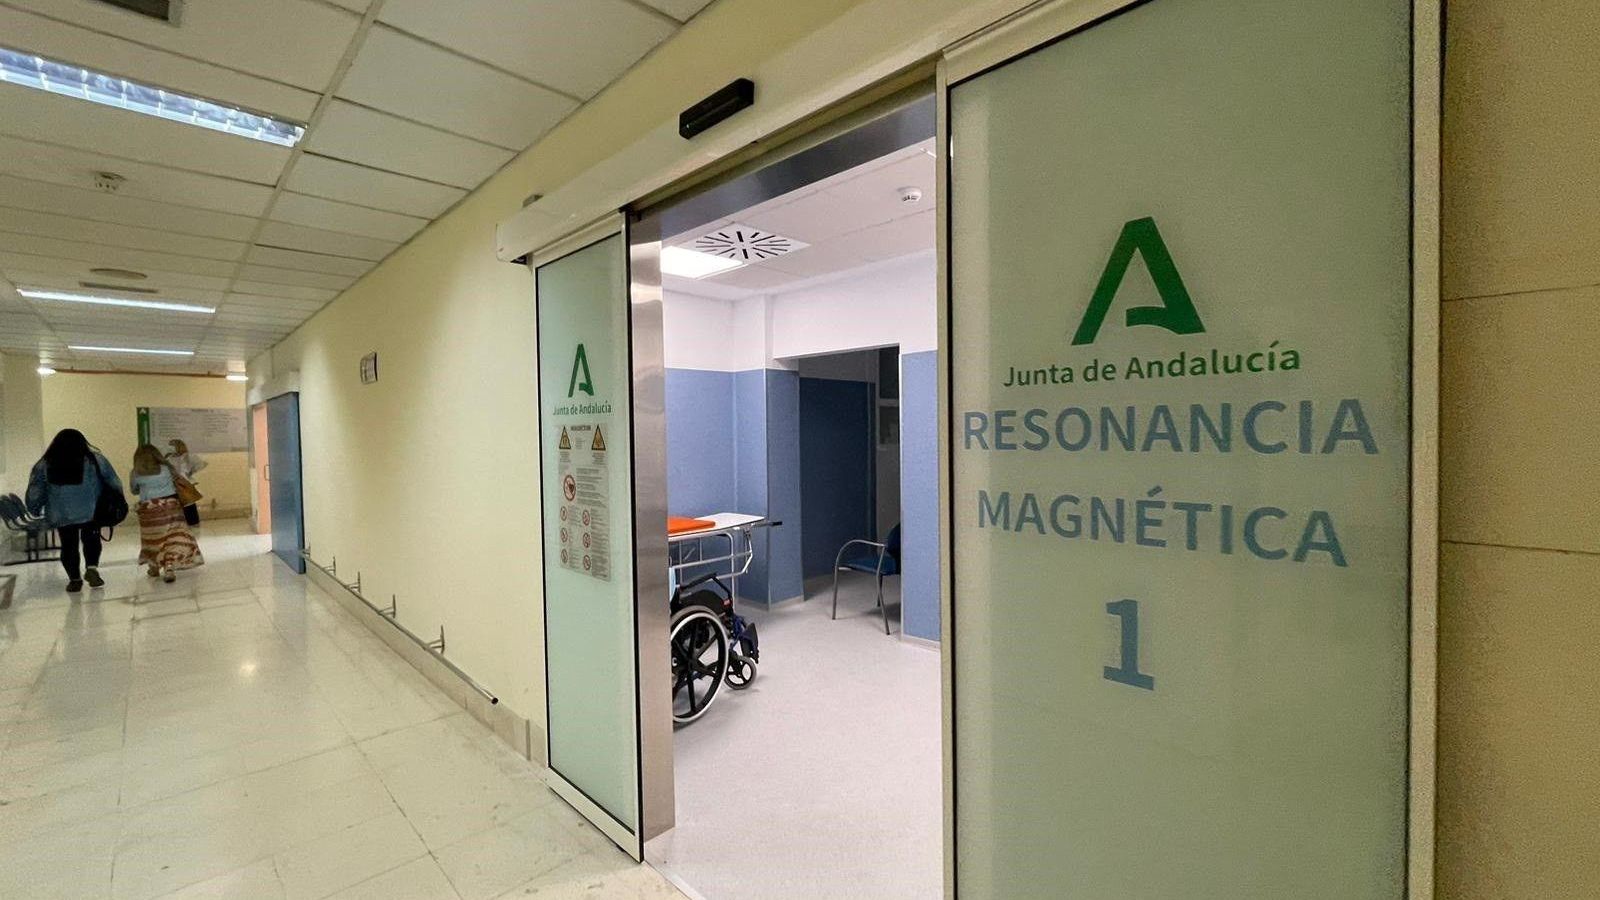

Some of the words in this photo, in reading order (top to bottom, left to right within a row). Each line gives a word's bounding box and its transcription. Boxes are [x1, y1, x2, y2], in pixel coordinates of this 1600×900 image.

[1003, 365, 1074, 387] Junta
[1083, 359, 1117, 382] de
[1125, 340, 1301, 380] Andalucía
[570, 404, 578, 415] de
[579, 400, 612, 415] Andalucía
[963, 398, 1380, 455] RESONANCIA
[977, 486, 1349, 568] MAGNÉTICA
[1103, 598, 1155, 691] 1
